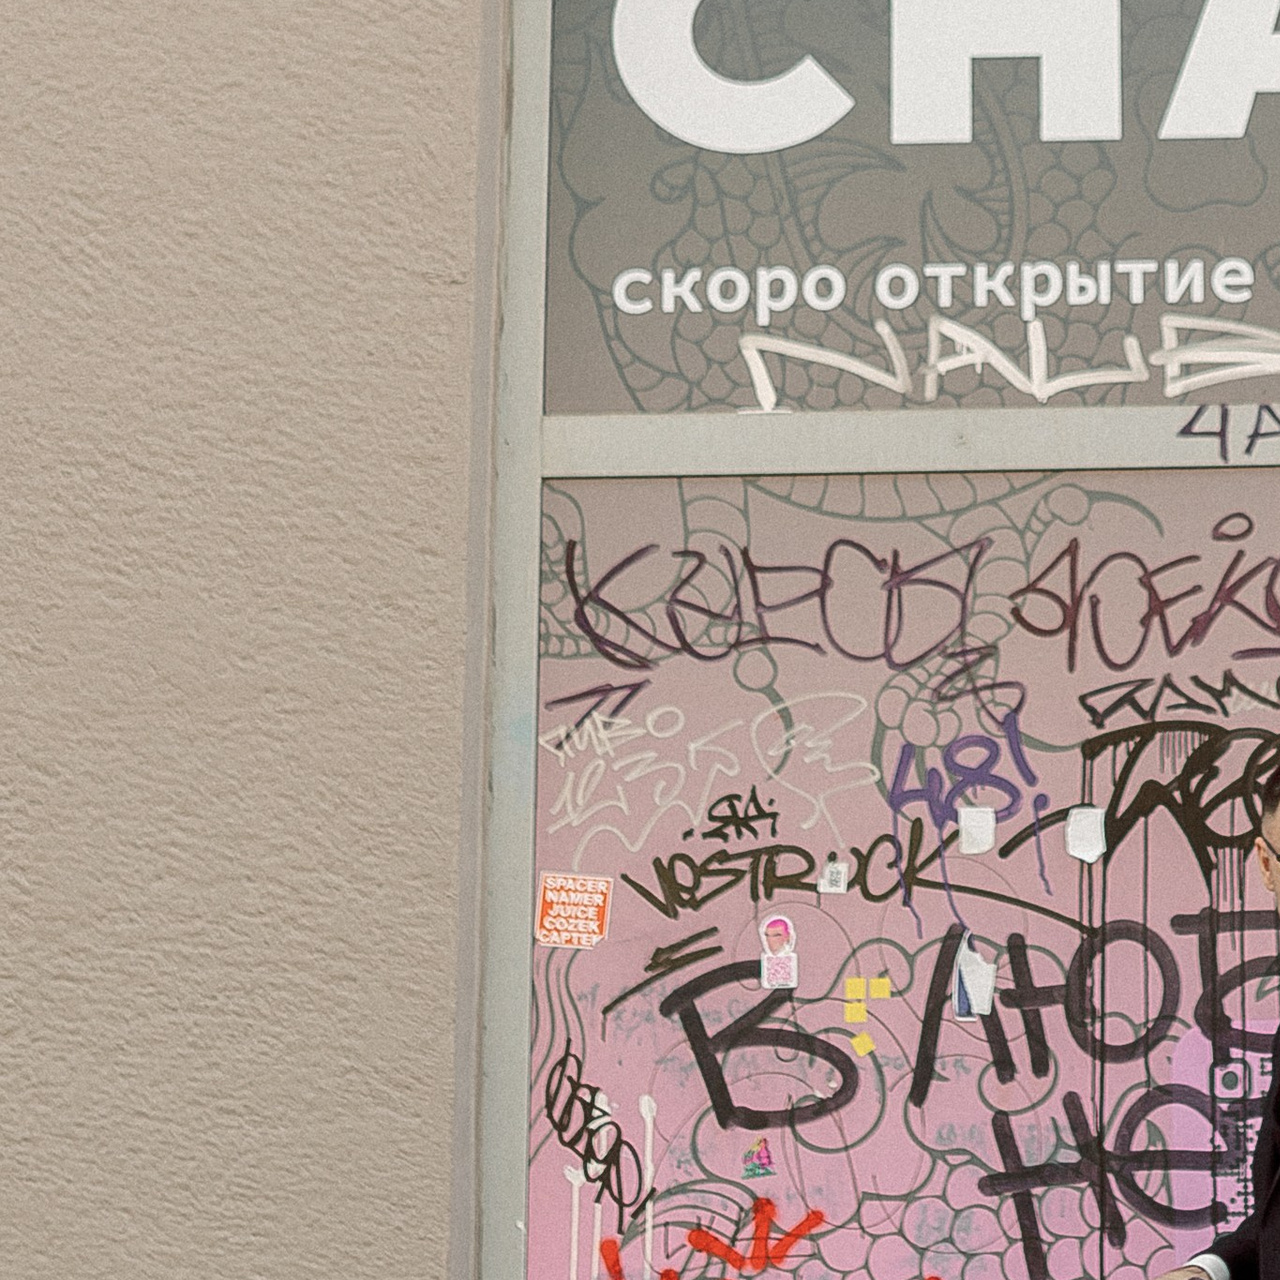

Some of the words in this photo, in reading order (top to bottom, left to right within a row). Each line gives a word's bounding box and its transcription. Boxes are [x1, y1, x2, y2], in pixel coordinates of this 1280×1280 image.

[611, 264, 847, 327] скоро
[875, 256, 1255, 322] открытие
[544, 876, 608, 893] SPACER
[544, 889, 605, 907] NAMER
[547, 903, 599, 920] JUICE
[542, 915, 601, 933] COZEK
